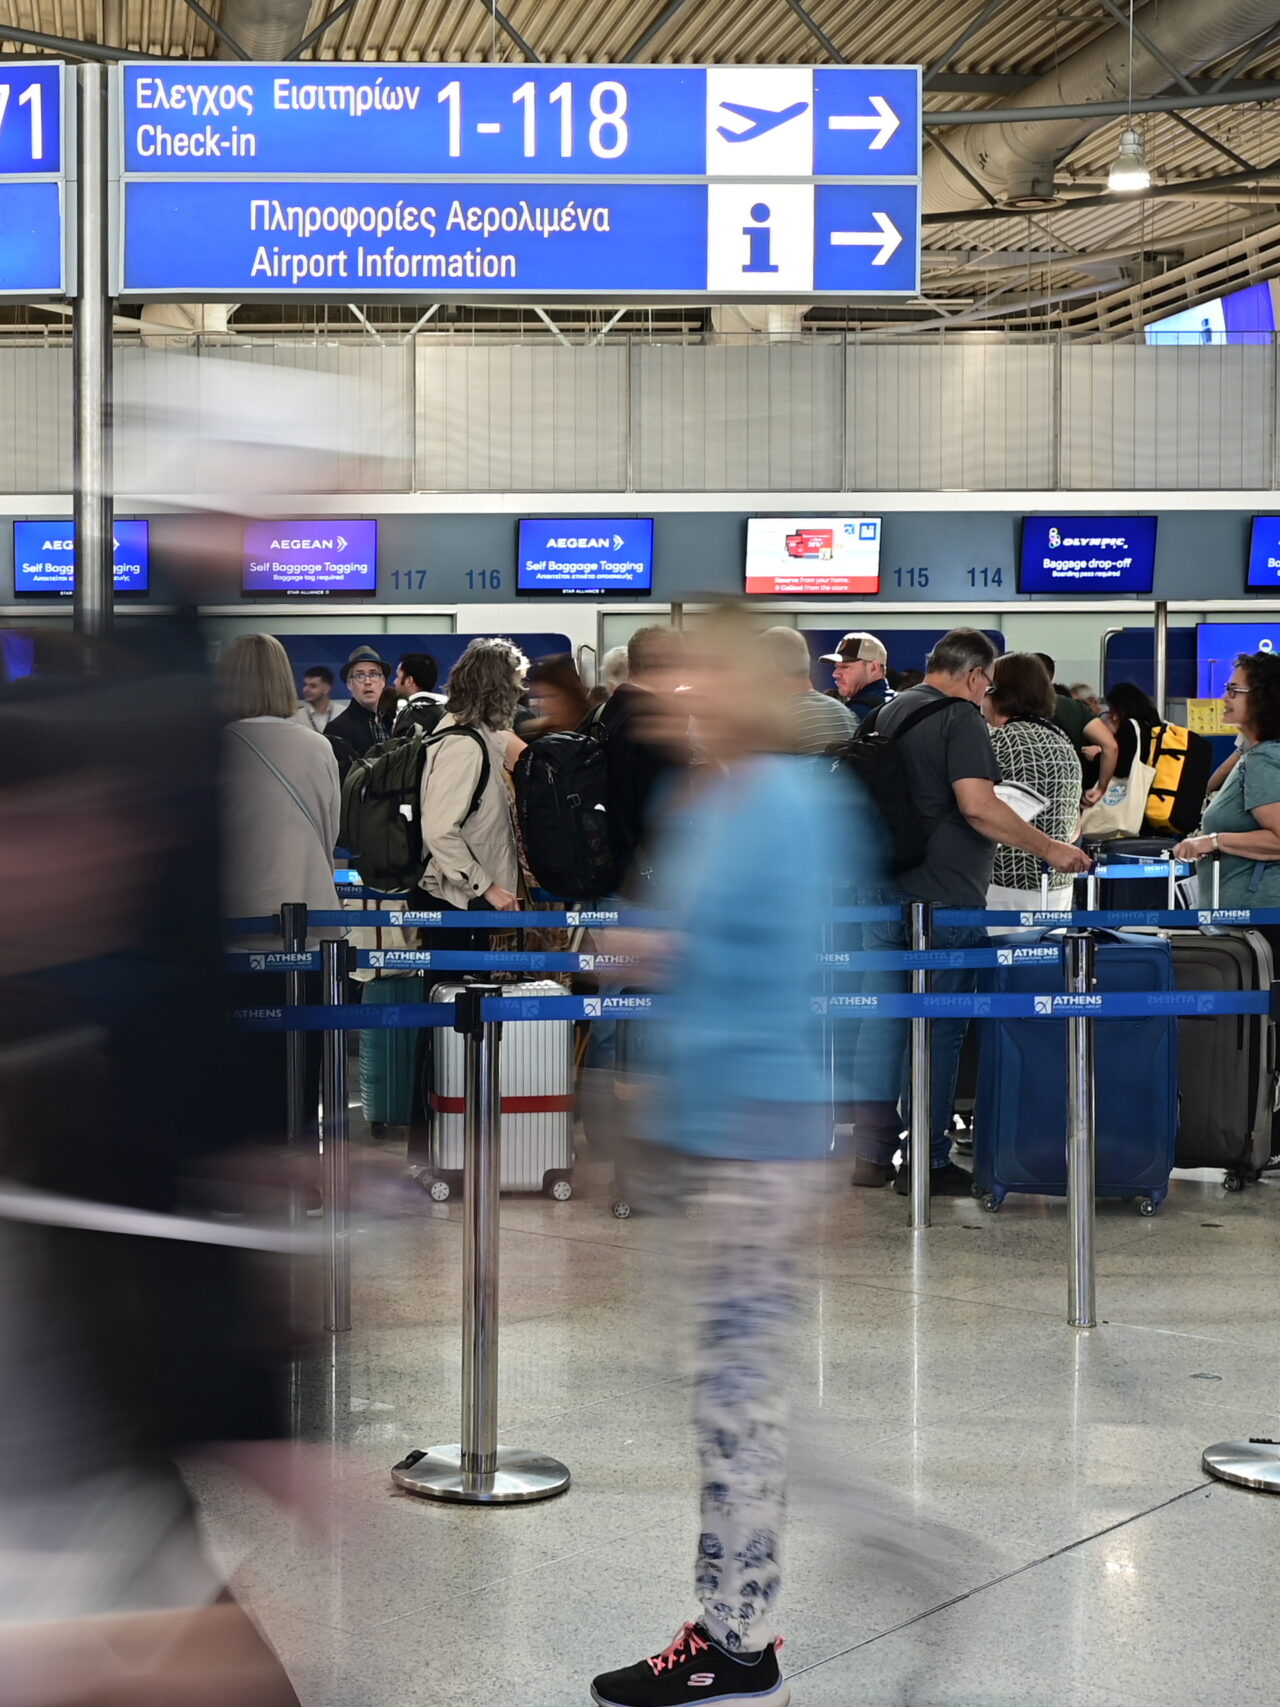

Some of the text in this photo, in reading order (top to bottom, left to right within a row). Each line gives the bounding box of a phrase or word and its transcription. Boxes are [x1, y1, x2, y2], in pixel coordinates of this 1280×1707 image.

[136, 77, 253, 115] Ελεγχος
[274, 77, 419, 115] Εισιτηρίων
[136, 125, 256, 156] Check-in
[250, 199, 610, 237] Πληροφορίες Αερολιμένα
[250, 246, 517, 284] Airport Information
[270, 539, 333, 550] AEGEAN
[546, 538, 610, 548] AEGEAN
[1062, 537, 1129, 549] OLYMPIC
[250, 562, 368, 574] Self Baggage Tagging
[525, 560, 644, 573] Self Baggage Tagging
[1043, 557, 1133, 571] Baggage drop-off
[273, 574, 345, 582] Baggage tag required
[893, 567, 930, 588] 115
[967, 567, 1003, 588] 114
[1052, 570, 1080, 578] Boarding
[1095, 570, 1121, 578] required
[390, 570, 428, 590] 117
[465, 569, 501, 590] 116
[403, 911, 442, 919] ATHENS
[579, 911, 619, 920] ATHENS
[1034, 911, 1073, 920] ATHENS
[1212, 909, 1251, 919] ATHENS
[385, 951, 431, 960] ATHENS
[1013, 947, 1059, 956] ATHENS
[266, 953, 313, 963] ATHENS
[602, 997, 652, 1007] ATHENS
[829, 996, 878, 1006] ATHENS
[1053, 995, 1102, 1005] ATHENS
